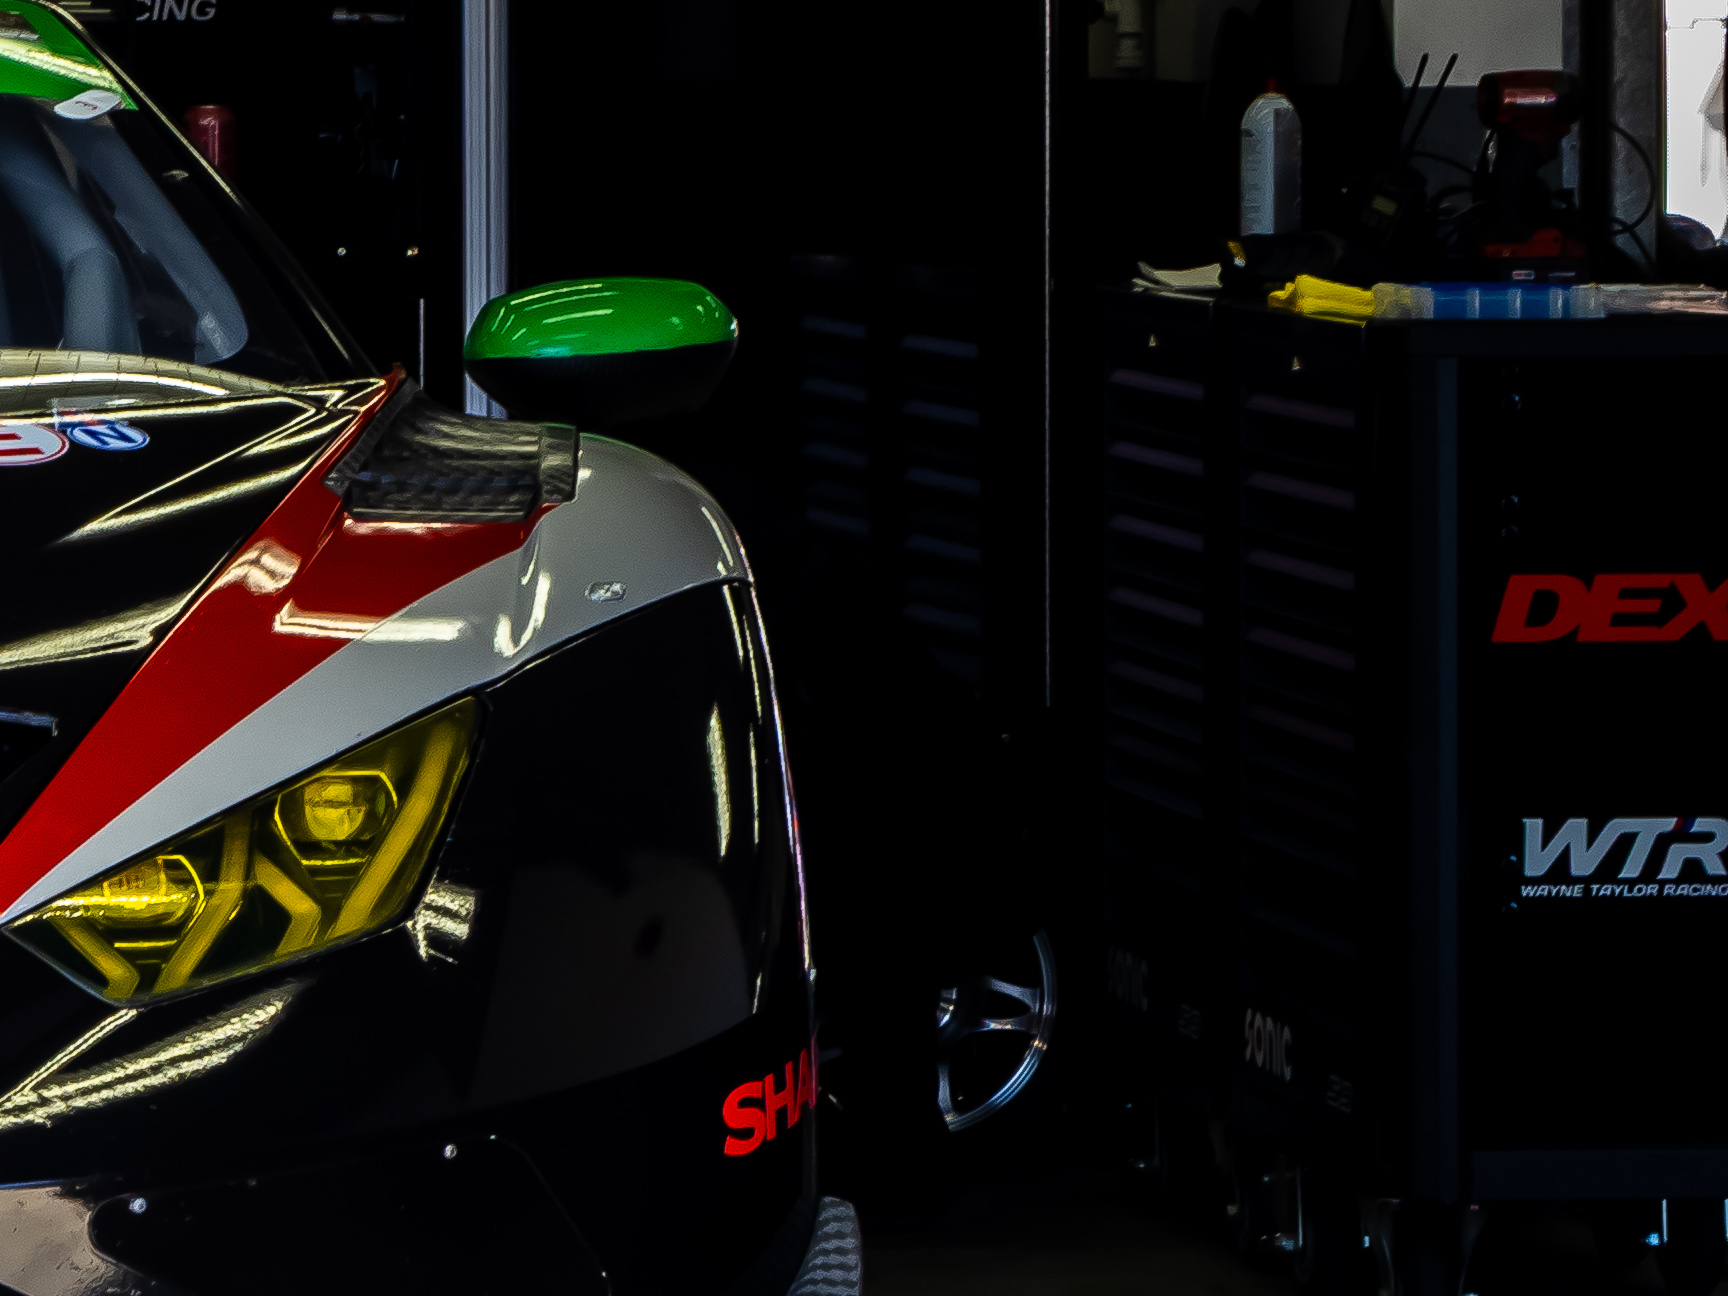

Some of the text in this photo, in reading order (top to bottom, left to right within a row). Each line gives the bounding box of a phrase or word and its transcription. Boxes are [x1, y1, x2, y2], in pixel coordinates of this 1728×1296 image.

[82, 425, 137, 446] N
[1490, 573, 1728, 644] DEX
[1521, 817, 1728, 880] WTR
[1521, 883, 1585, 898] WAYNE
[1590, 883, 1659, 898] TAYLOR
